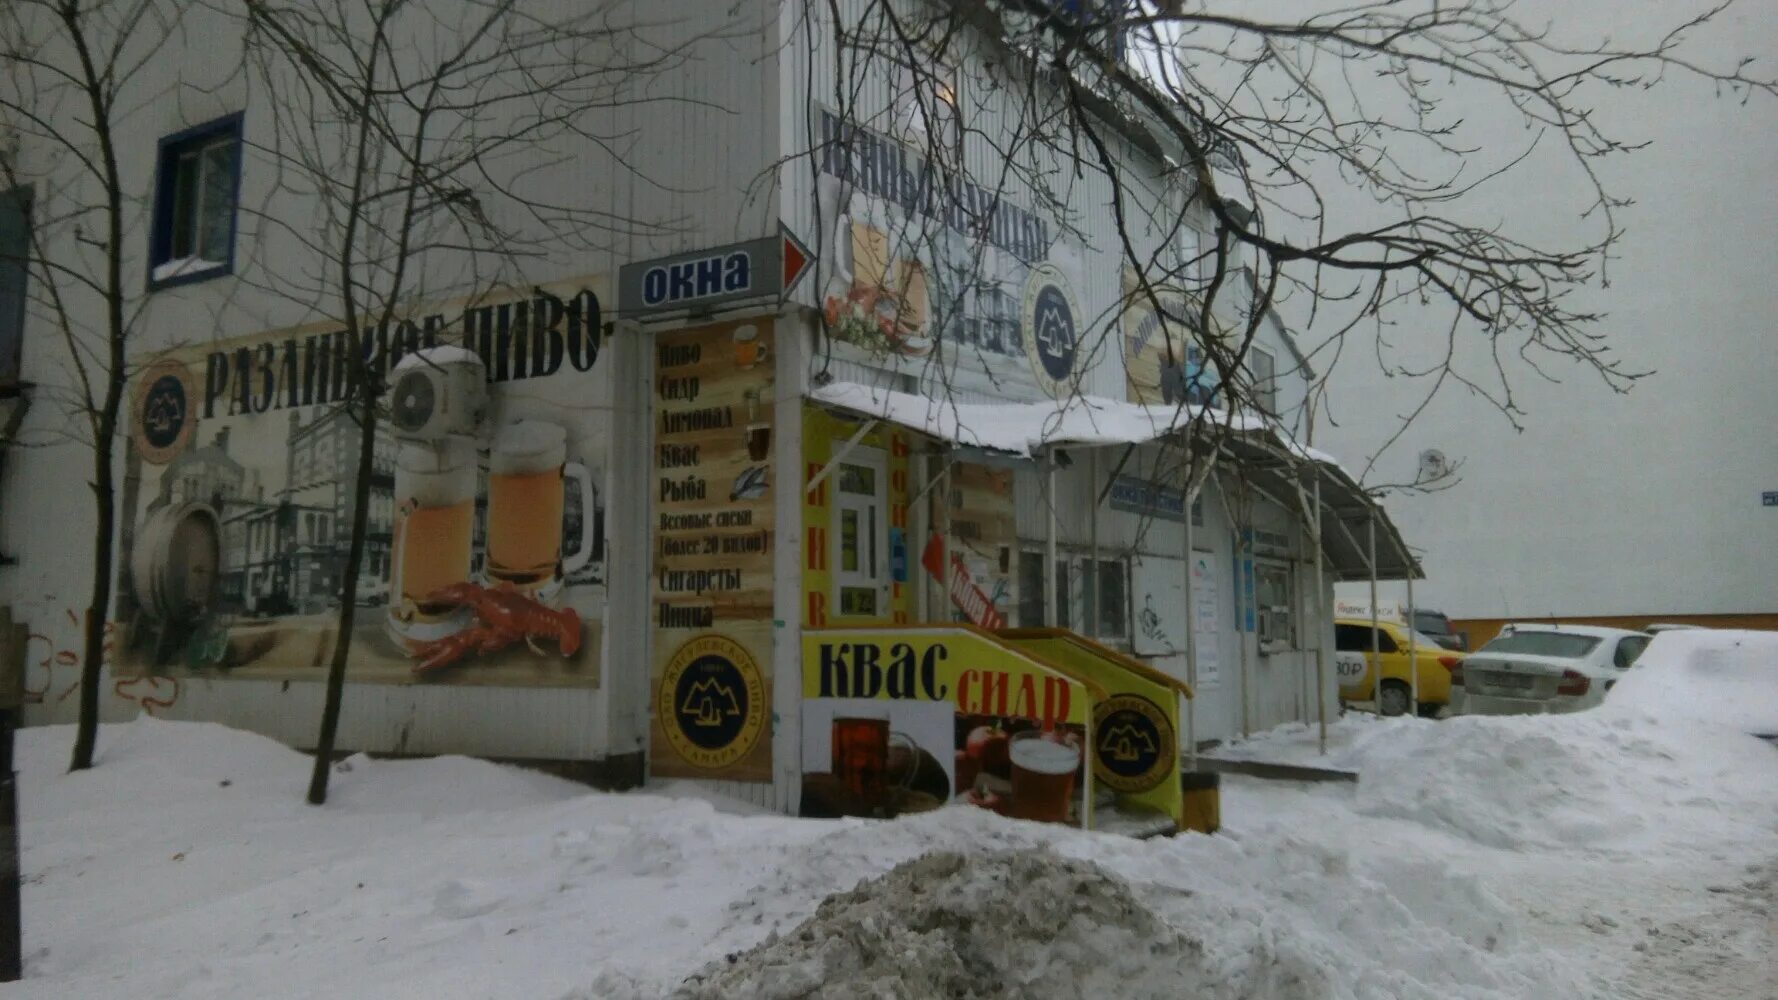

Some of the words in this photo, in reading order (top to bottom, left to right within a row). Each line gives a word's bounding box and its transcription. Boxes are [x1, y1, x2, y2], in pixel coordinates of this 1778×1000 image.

[462, 289, 602, 383] ПИВО
[660, 376, 701, 401] Сидр
[660, 444, 701, 468] Квас
[660, 475, 707, 502] Рыба
[659, 565, 742, 597] Сигареты
